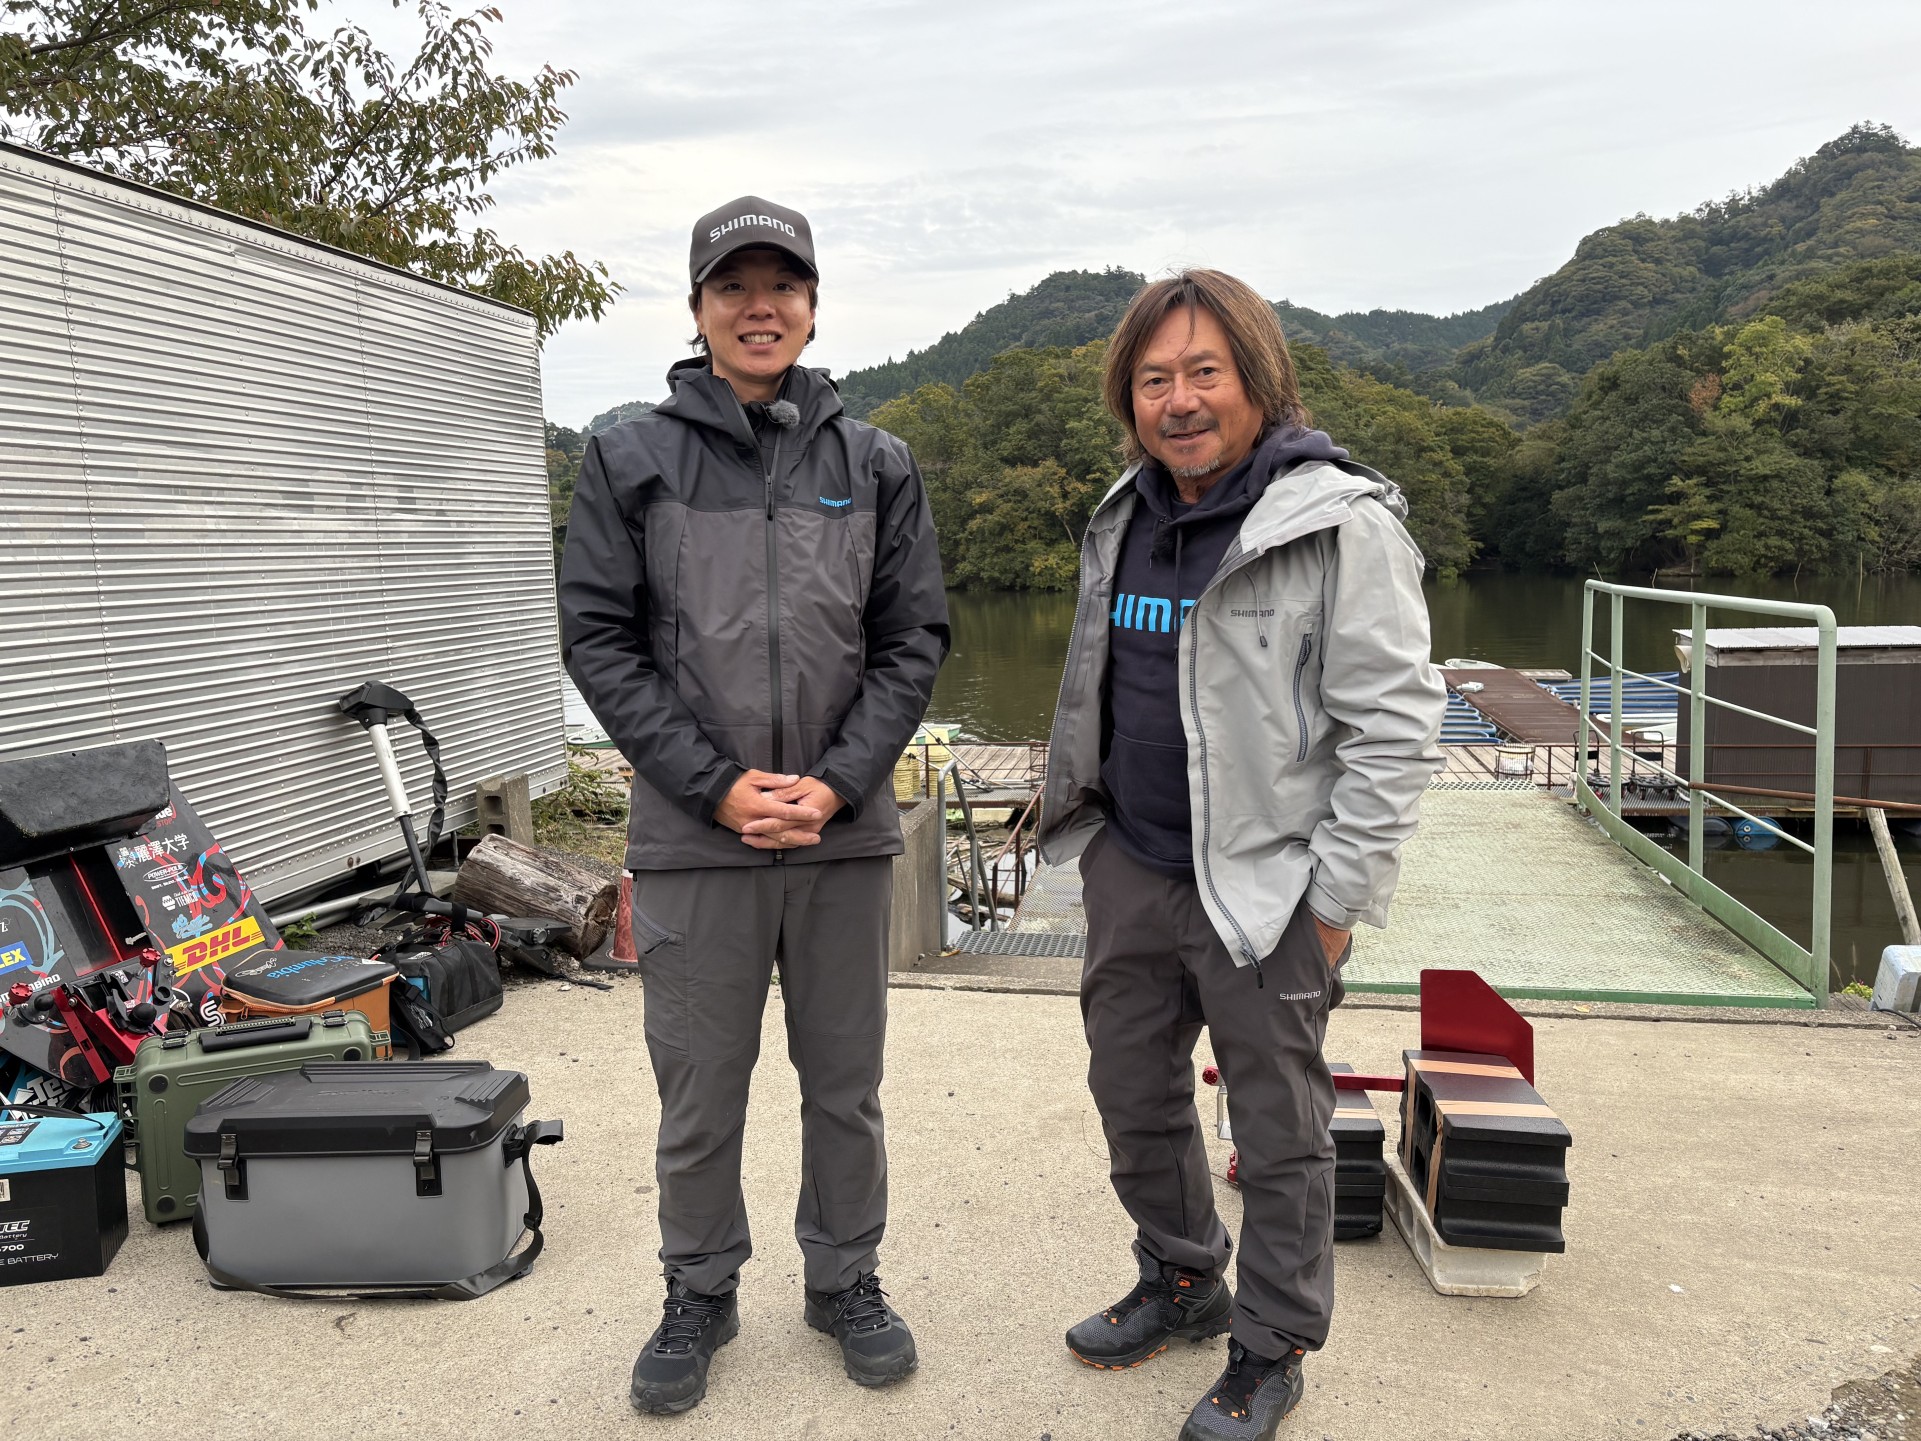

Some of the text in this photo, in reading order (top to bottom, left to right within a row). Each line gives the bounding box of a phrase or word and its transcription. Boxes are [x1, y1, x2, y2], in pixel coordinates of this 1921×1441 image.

[709, 214, 796, 243] SHIMANO
[819, 496, 852, 508] SHIMANO
[1230, 609, 1275, 618] SHIMANO
[182, 925, 251, 968] DHL
[1279, 990, 1321, 1001] SHIMANO
[0, 1243, 25, 1253] 700
[7, 1252, 60, 1266] BATTERY
